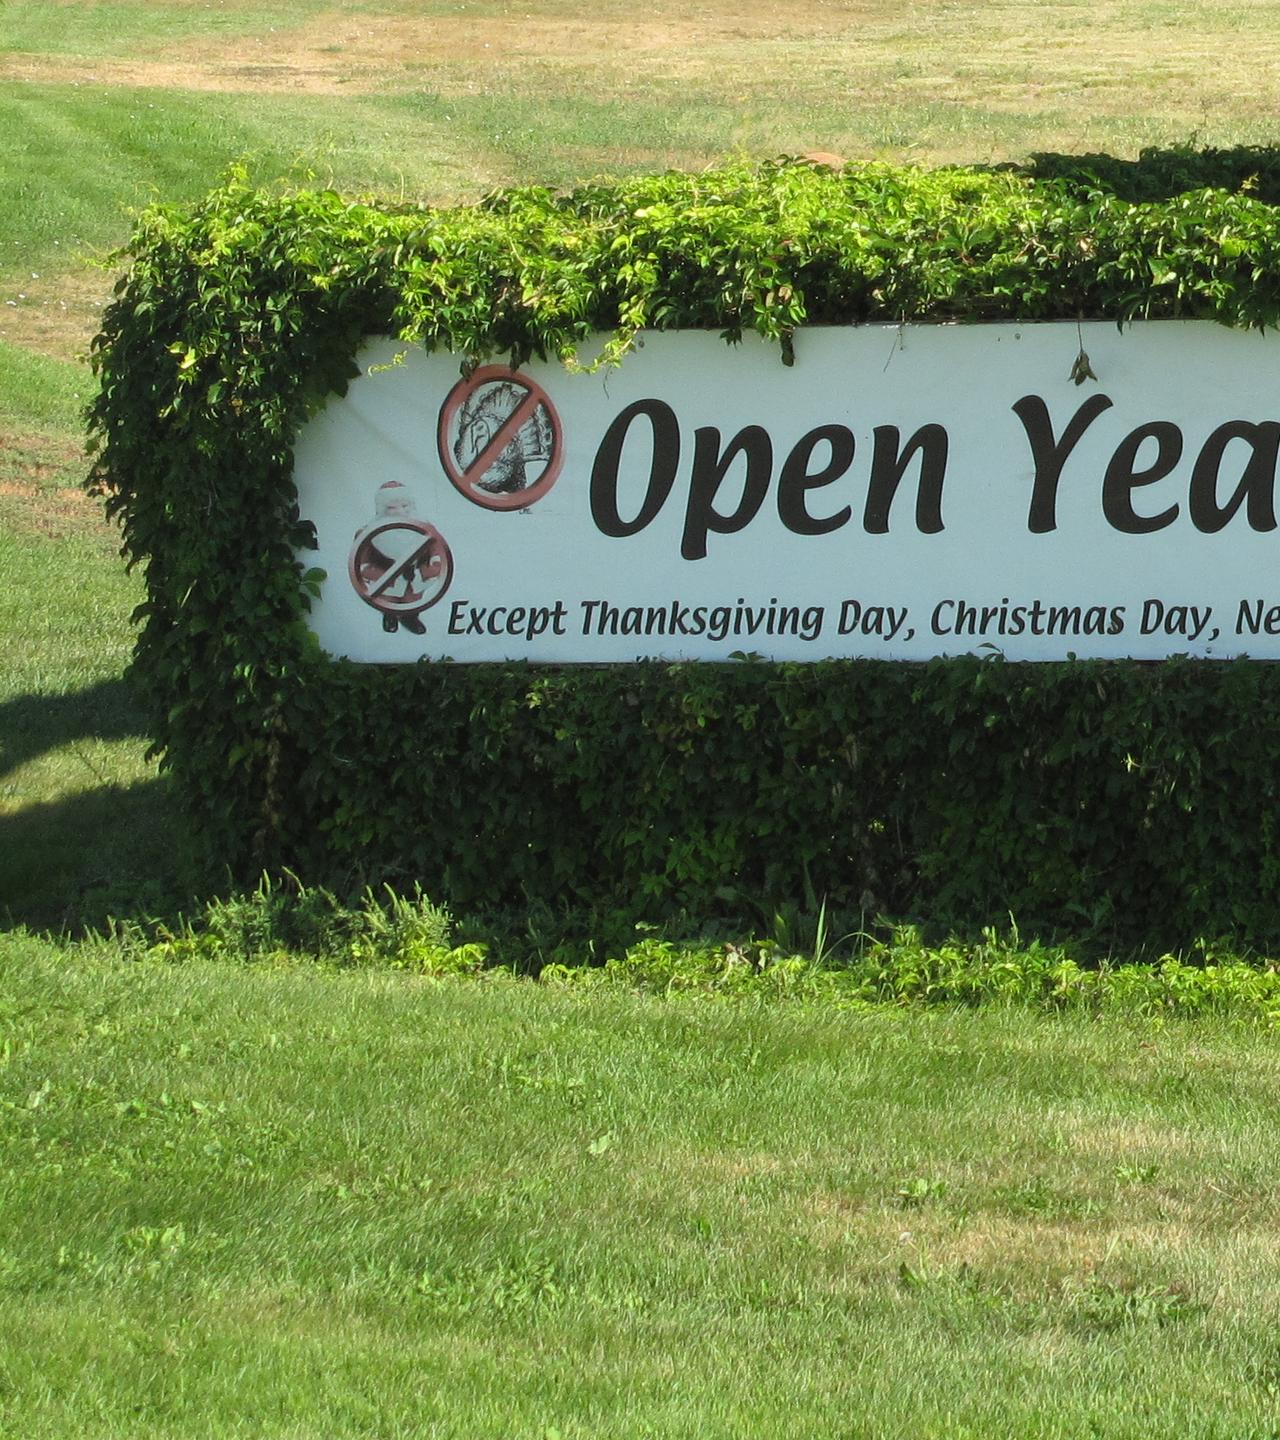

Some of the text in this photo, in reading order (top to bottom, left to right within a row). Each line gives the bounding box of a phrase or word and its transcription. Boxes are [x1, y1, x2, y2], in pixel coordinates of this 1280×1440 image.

[589, 398, 949, 561] Open
[446, 599, 568, 641] Except
[580, 598, 825, 642] Thanksgiving
[838, 599, 915, 641] Day,
[930, 597, 1126, 637] Christmas
[1139, 599, 1220, 641] Day,
